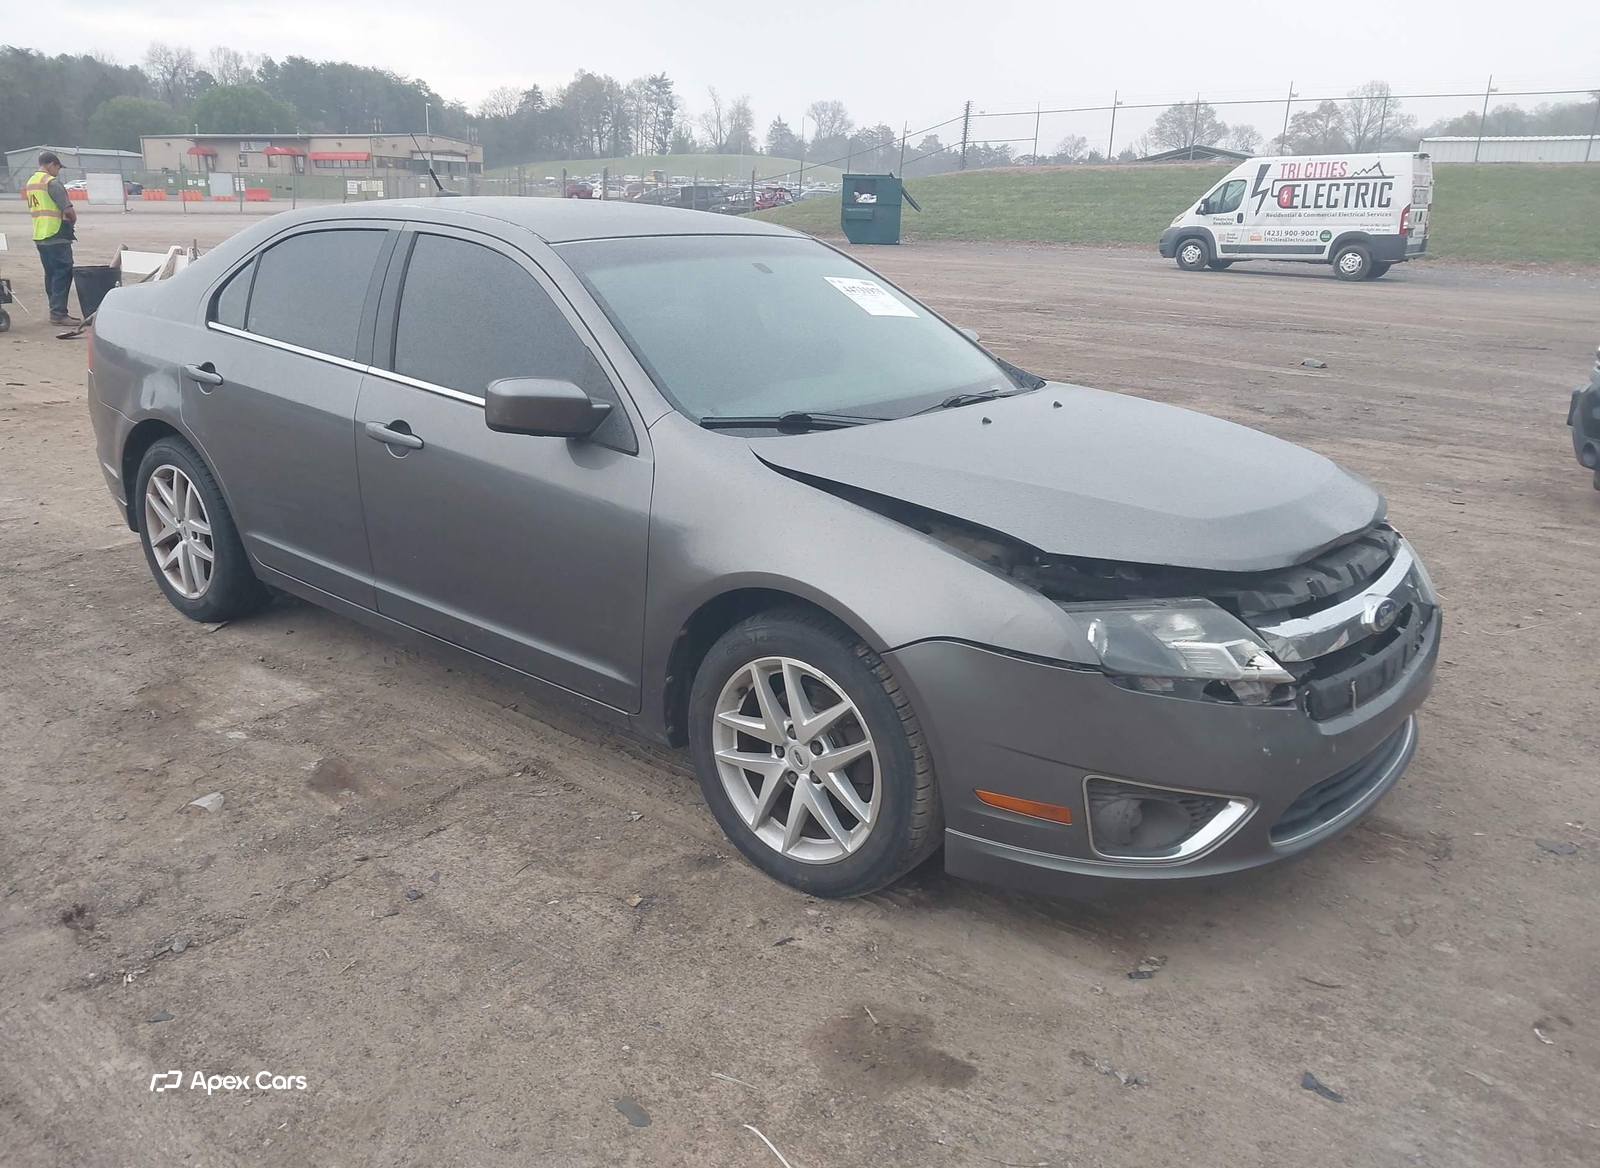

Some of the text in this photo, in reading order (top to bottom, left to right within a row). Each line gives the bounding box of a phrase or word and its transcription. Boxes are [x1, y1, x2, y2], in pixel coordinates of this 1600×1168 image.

[1281, 161, 1349, 179] TRI CITIES
[1287, 182, 1393, 209] ELECTRIC
